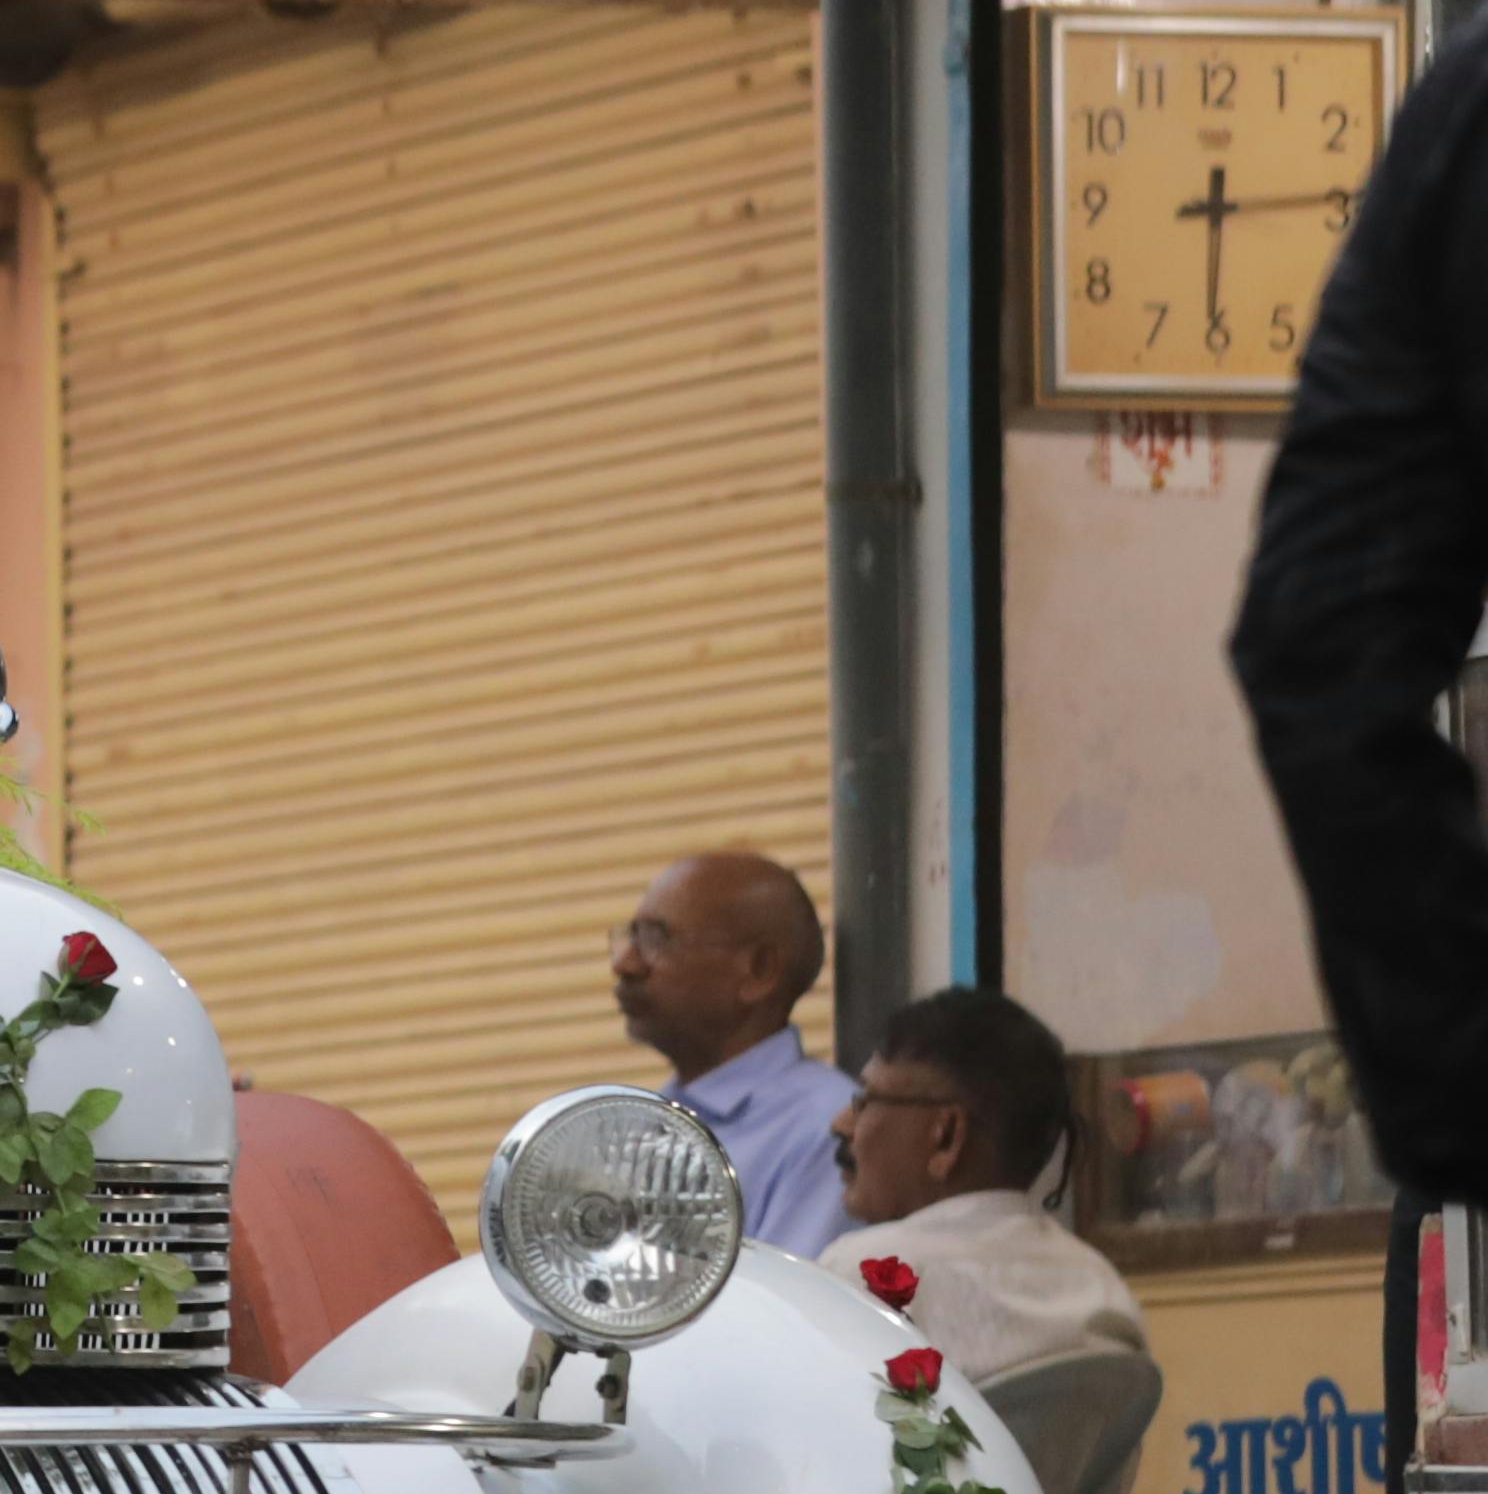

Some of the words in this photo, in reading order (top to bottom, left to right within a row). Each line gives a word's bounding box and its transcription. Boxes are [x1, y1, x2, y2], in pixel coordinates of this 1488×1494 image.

[1137, 63, 1166, 109] 11
[1198, 61, 1238, 109] 12
[1272, 64, 1288, 111] 1
[1083, 109, 1126, 155] 10
[1321, 104, 1349, 154] 2
[1082, 181, 1109, 229] 9
[1085, 258, 1112, 306] 8
[1143, 302, 1171, 349] 7
[1204, 309, 1231, 355] 6
[1268, 302, 1296, 354] 5
